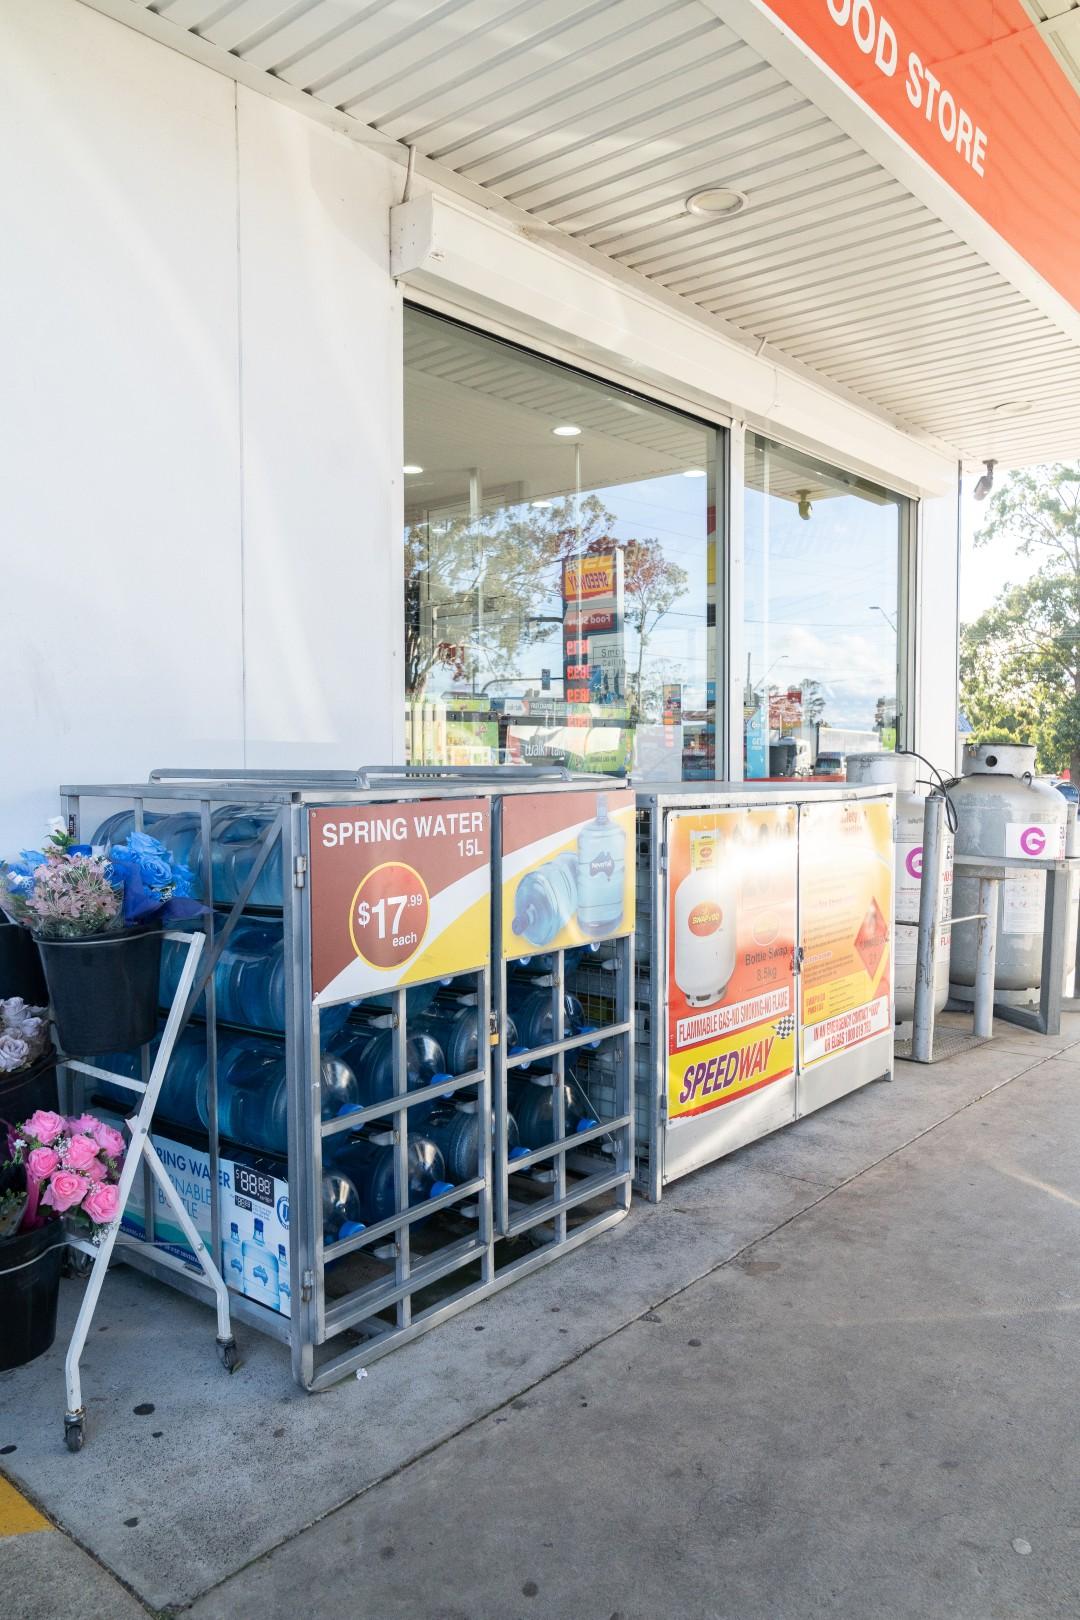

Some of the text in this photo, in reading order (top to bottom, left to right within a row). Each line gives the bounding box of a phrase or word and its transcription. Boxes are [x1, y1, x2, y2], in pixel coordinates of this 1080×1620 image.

[905, 51, 988, 178] STORE
[321, 811, 483, 848] SPRING WATER
[457, 838, 484, 857] 15L
[392, 932, 417, 947] each
[745, 952, 767, 966] Bottle
[768, 946, 788, 961] Swap
[678, 1015, 718, 1042] FLAMMABLE
[772, 990, 788, 1011] FLAME
[680, 1036, 774, 1104] SPEEDWAY
[155, 1146, 231, 1189] RING WAER
[158, 1188, 198, 1219] BTLE
